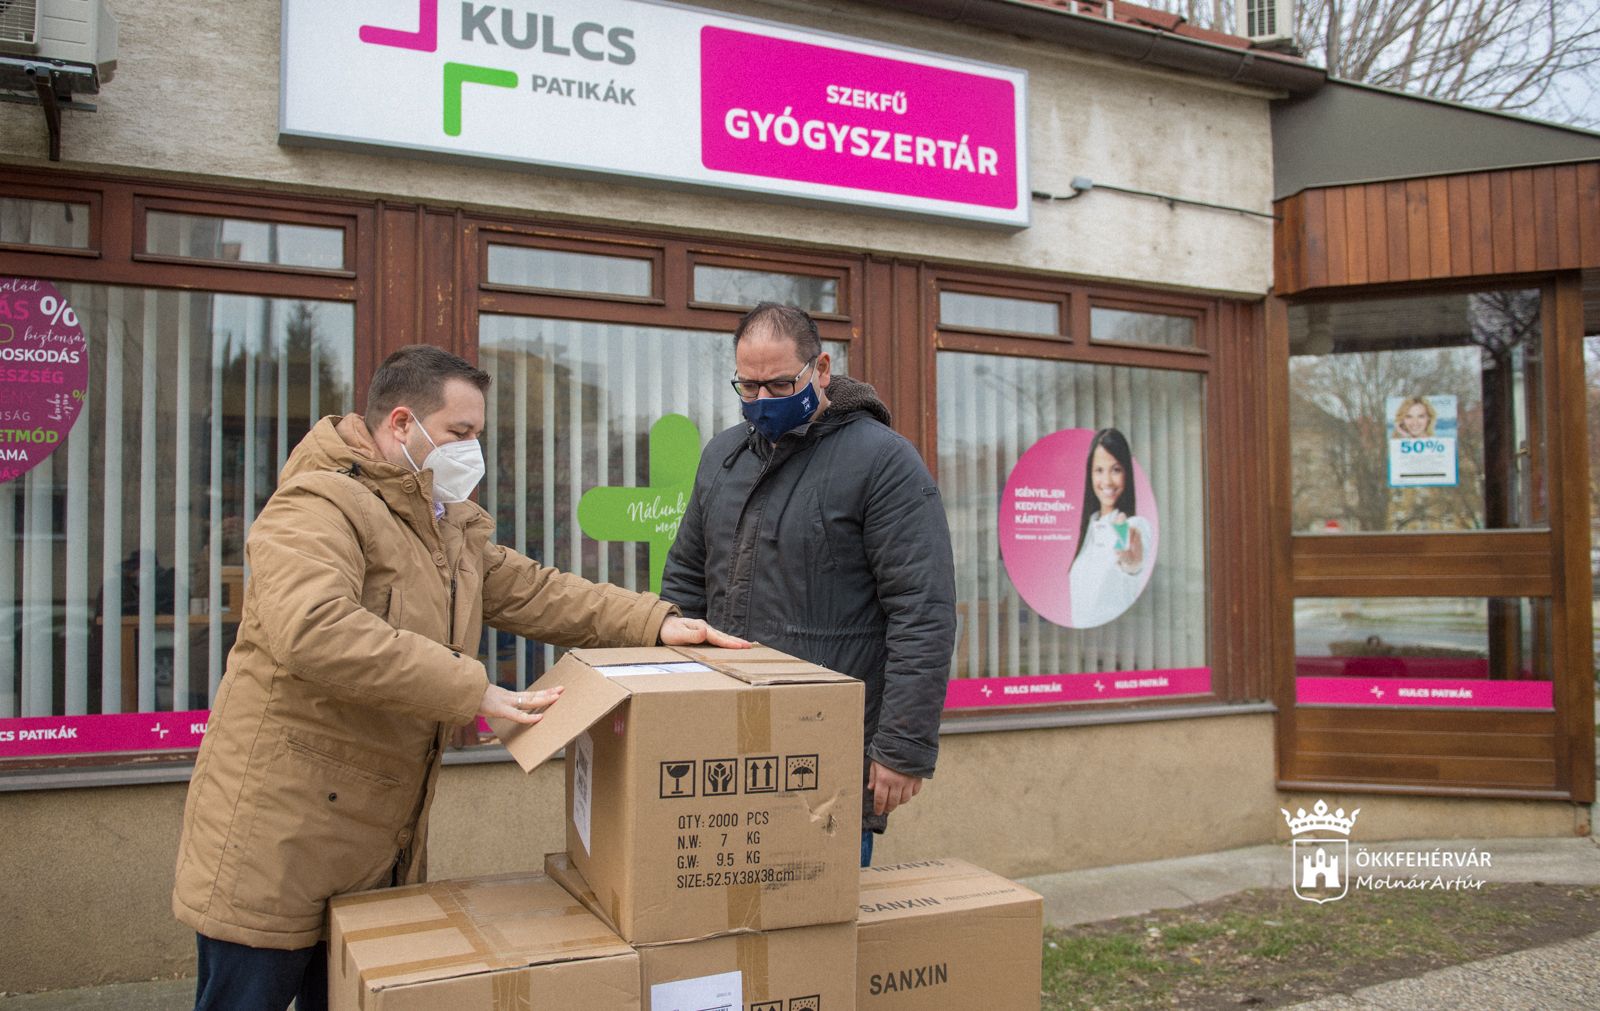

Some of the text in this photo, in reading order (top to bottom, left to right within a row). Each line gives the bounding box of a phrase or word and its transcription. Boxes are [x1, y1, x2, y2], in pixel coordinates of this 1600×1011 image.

[461, 1, 636, 65] KULCS
[532, 74, 636, 106] PATIKÁK
[826, 84, 907, 114] SZEKFŰ
[724, 106, 998, 176] GYÓGYSZERTÁR
[0, 278, 40, 292] alád
[0, 347, 80, 363] OSKODÁS
[0, 409, 31, 421] SÁG
[1401, 440, 1445, 454] 50%
[627, 492, 687, 523] Nálunk
[1004, 681, 1062, 695] KULCS PATIKÁK
[1398, 687, 1473, 699] KULCS PATIKÁK
[18, 725, 78, 740] PATIKÁK
[678, 811, 769, 829] QTY: 2000 PCS
[677, 831, 760, 849] N.W: 7 KG
[677, 850, 760, 869] G.W: 9.5 KG
[859, 897, 941, 913] SANXIN
[869, 962, 948, 996] SANXIN
